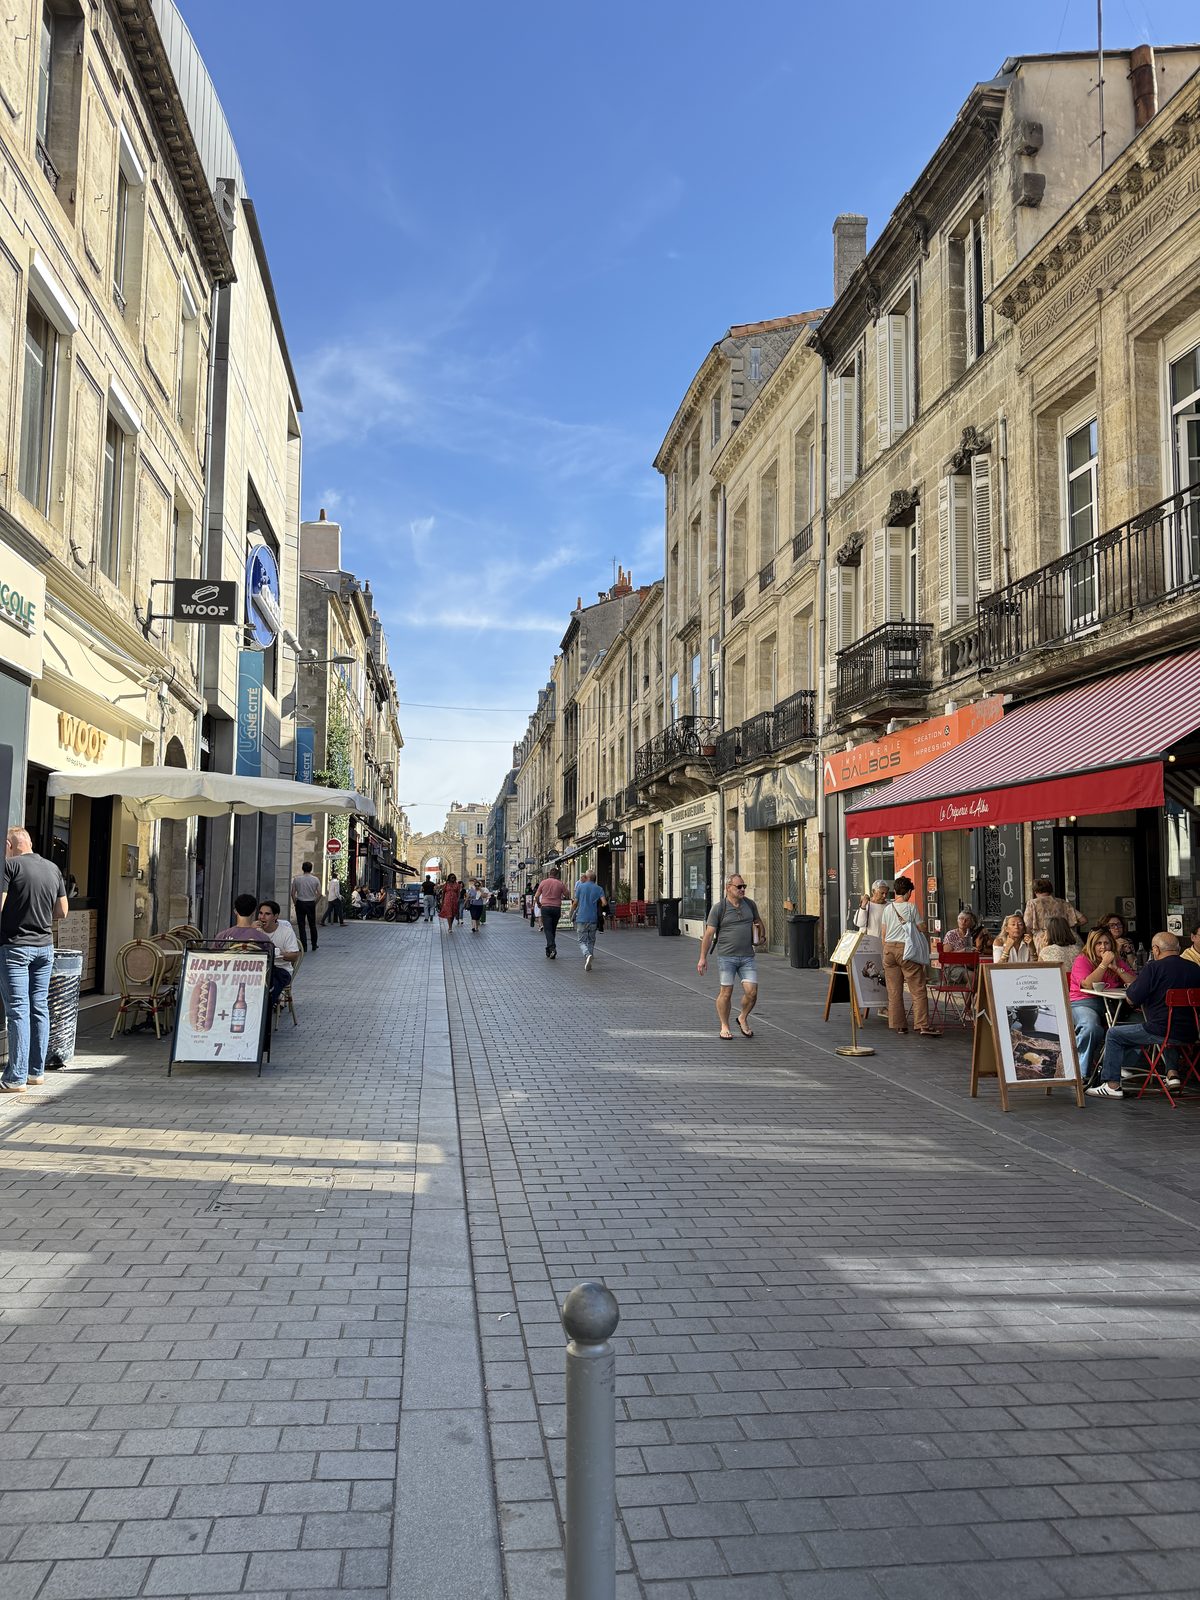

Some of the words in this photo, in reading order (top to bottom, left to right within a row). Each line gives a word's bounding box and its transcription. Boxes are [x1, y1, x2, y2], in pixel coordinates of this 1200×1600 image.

[0, 580, 36, 625] COLE
[181, 604, 229, 616] WOOF
[247, 687, 258, 711] CITÉ
[58, 711, 107, 760] WOOF
[247, 713, 257, 739] CINÉ
[913, 731, 942, 745] CRÉATION
[841, 741, 901, 766] IMPRIMERIE
[913, 740, 952, 757] IMPRESSION
[303, 752, 312, 769] CITÉ
[841, 751, 901, 781] DALBOS
[190, 958, 232, 971] HAPPY
[232, 959, 264, 972] HOUR
[188, 972, 229, 985] HAPPY
[230, 974, 263, 986] HOUR
